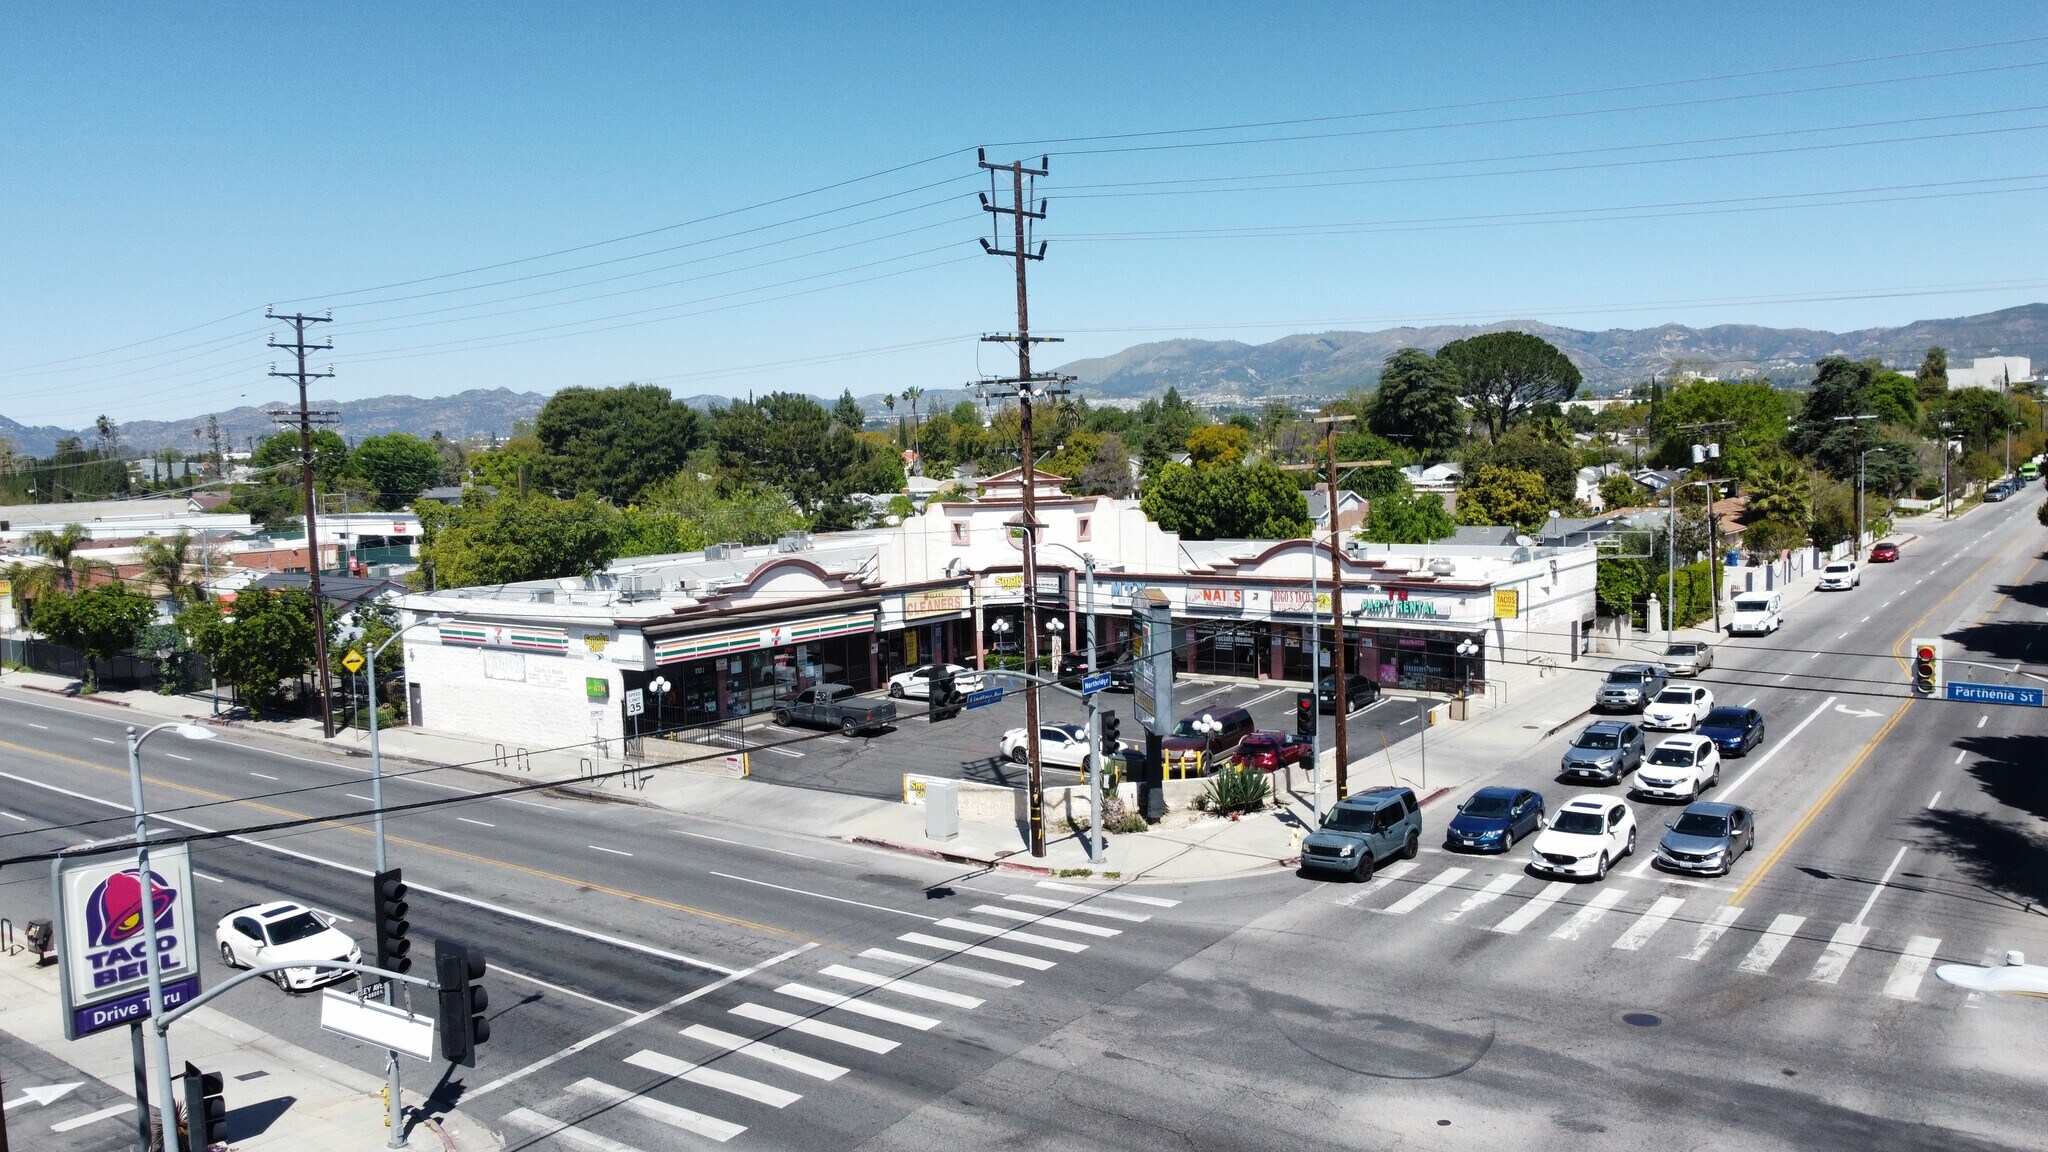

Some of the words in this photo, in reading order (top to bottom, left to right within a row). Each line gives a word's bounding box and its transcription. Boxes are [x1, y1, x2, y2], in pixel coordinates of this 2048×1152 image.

[995, 575, 1023, 586] Smok
[907, 597, 961, 616] CLEANERS
[1361, 599, 1394, 613] PARTY
[1396, 600, 1437, 615] RENTAL
[1497, 595, 1516, 604] TACOS
[584, 633, 609, 646] Smoke
[593, 685, 606, 693] ATM
[1955, 685, 2015, 701] Parthenia
[2020, 691, 2035, 702] St
[629, 702, 642, 713] 35
[86, 935, 177, 970] TACO
[93, 954, 180, 988] BELL
[94, 1006, 139, 1026] Drive
[142, 992, 181, 1011] Tru
